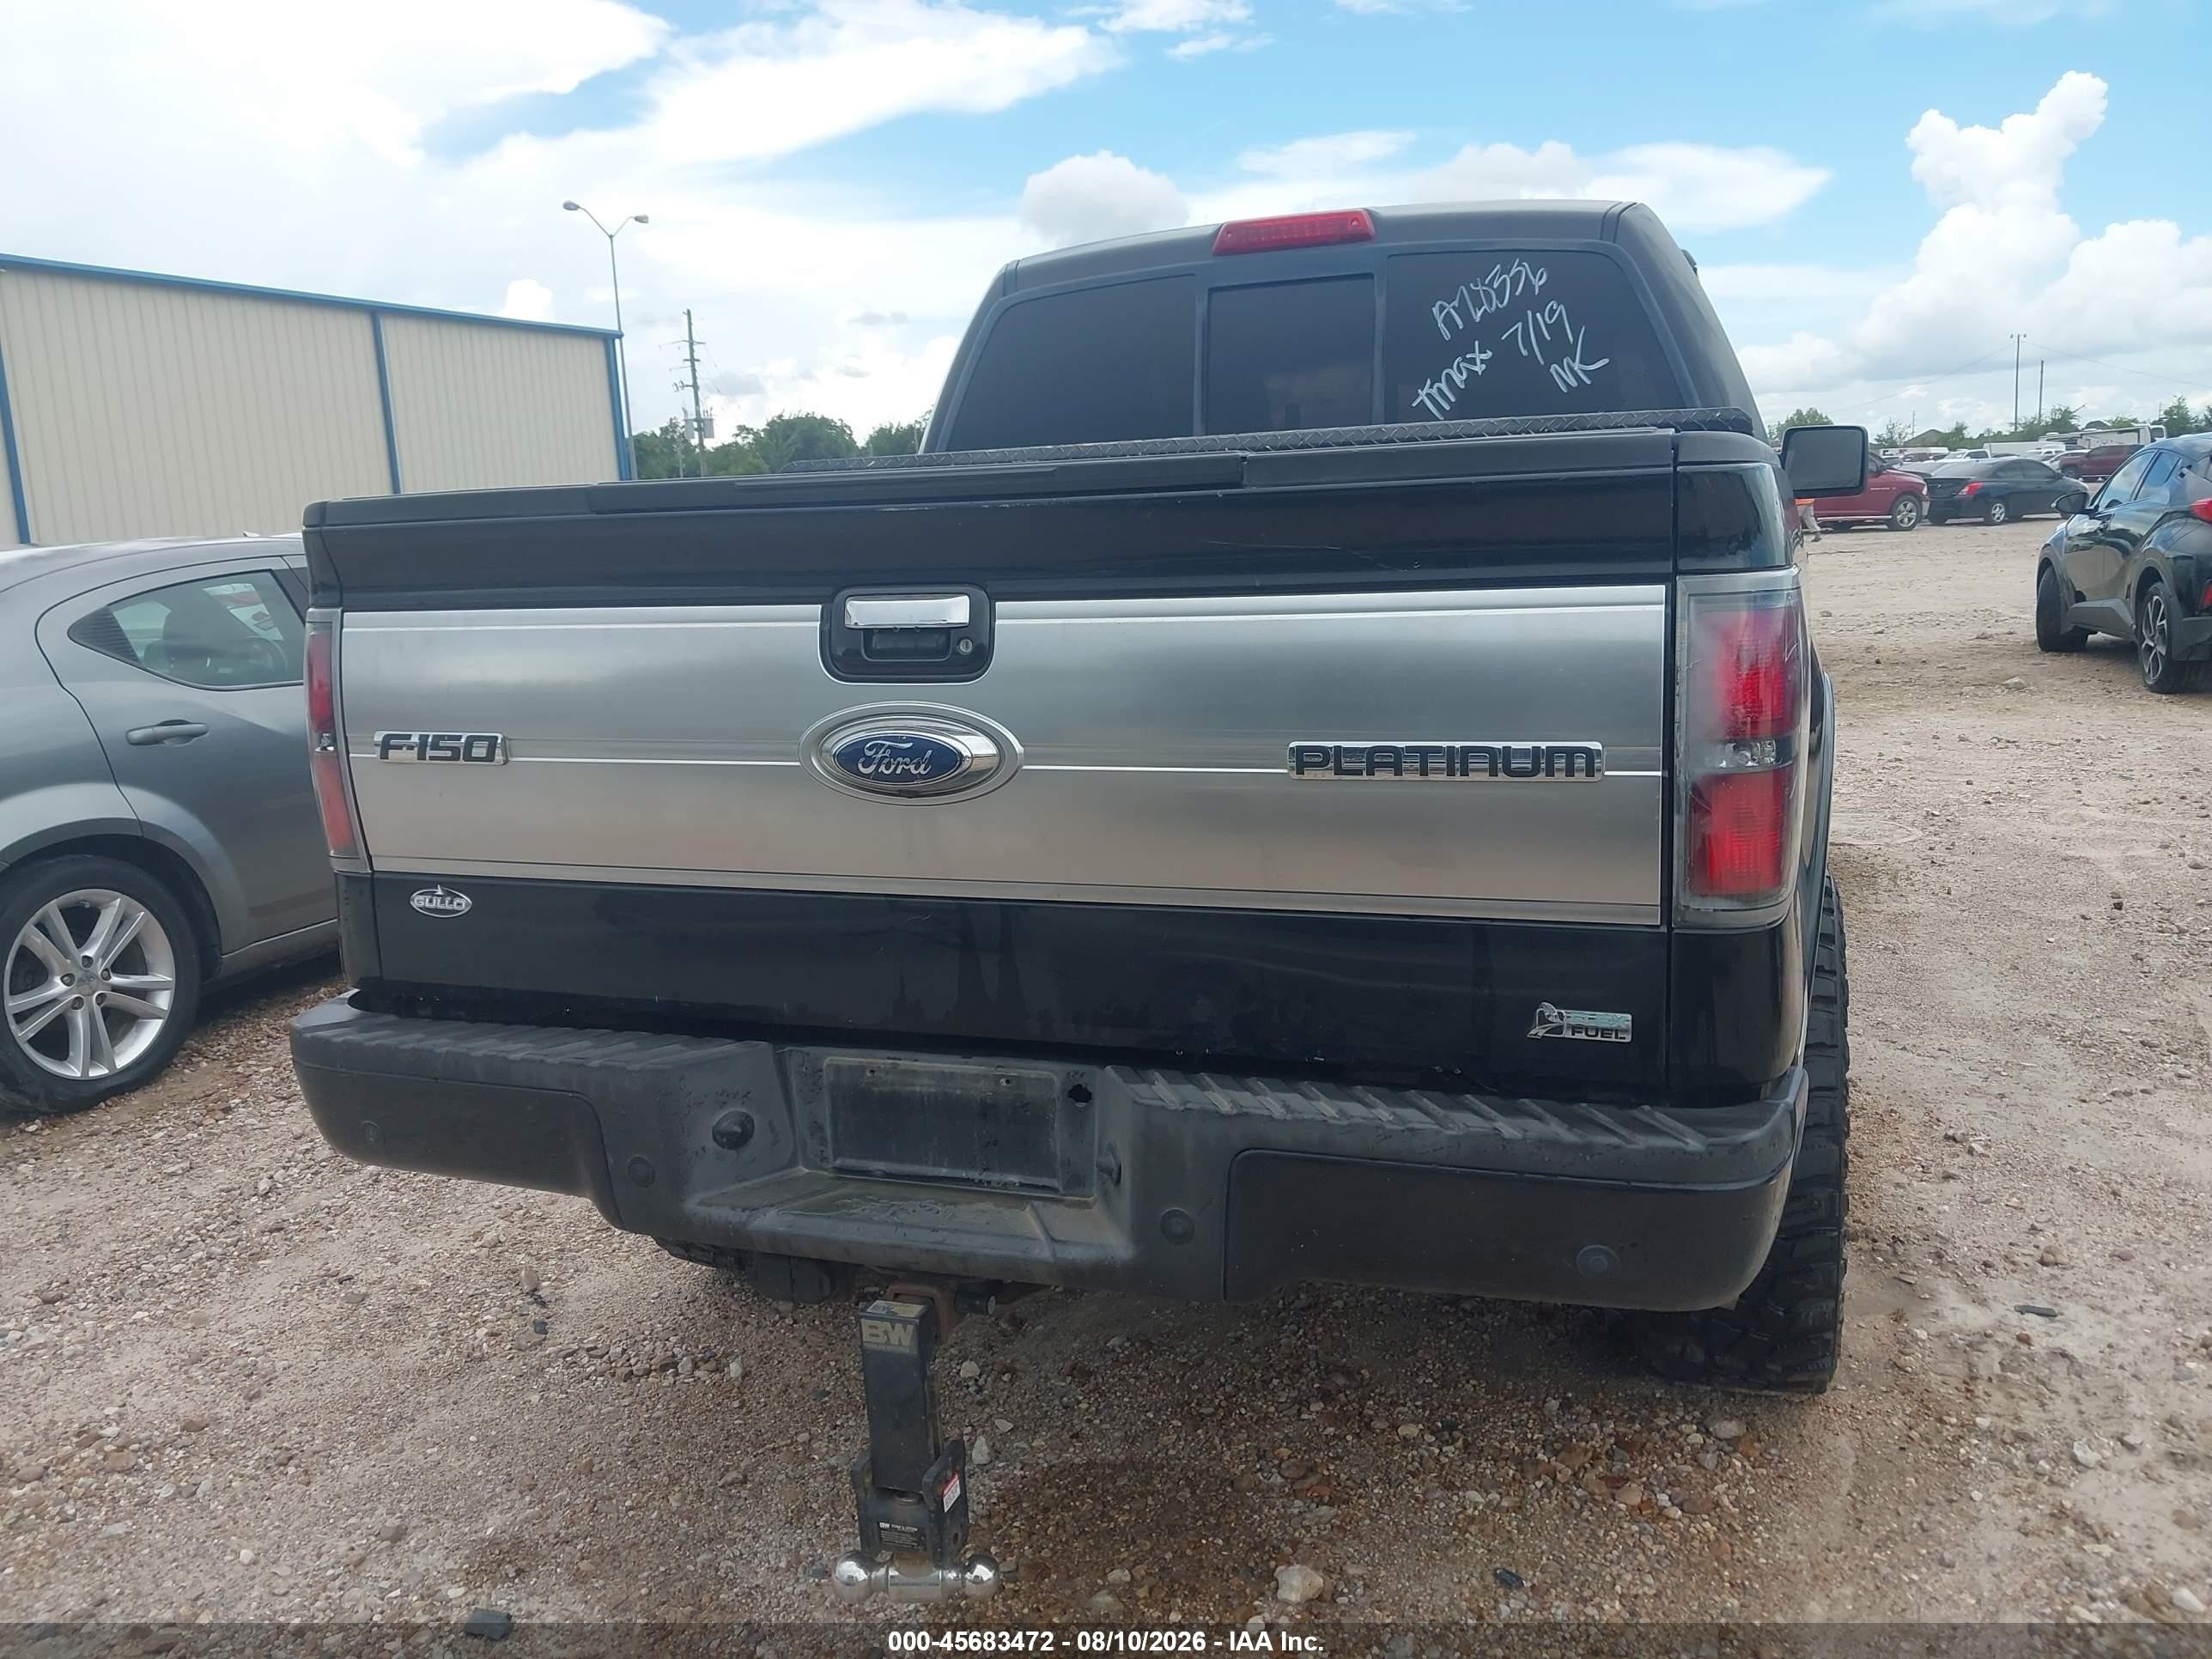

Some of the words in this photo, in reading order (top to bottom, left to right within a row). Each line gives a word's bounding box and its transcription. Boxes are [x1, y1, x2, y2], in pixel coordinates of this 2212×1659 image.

[1501, 301, 1574, 365] 7/19
[858, 740, 933, 775] Ford
[1295, 744, 1595, 778] PLATINUM
[412, 895, 467, 911] GULLO
[1571, 1025, 1626, 1040] FUEL
